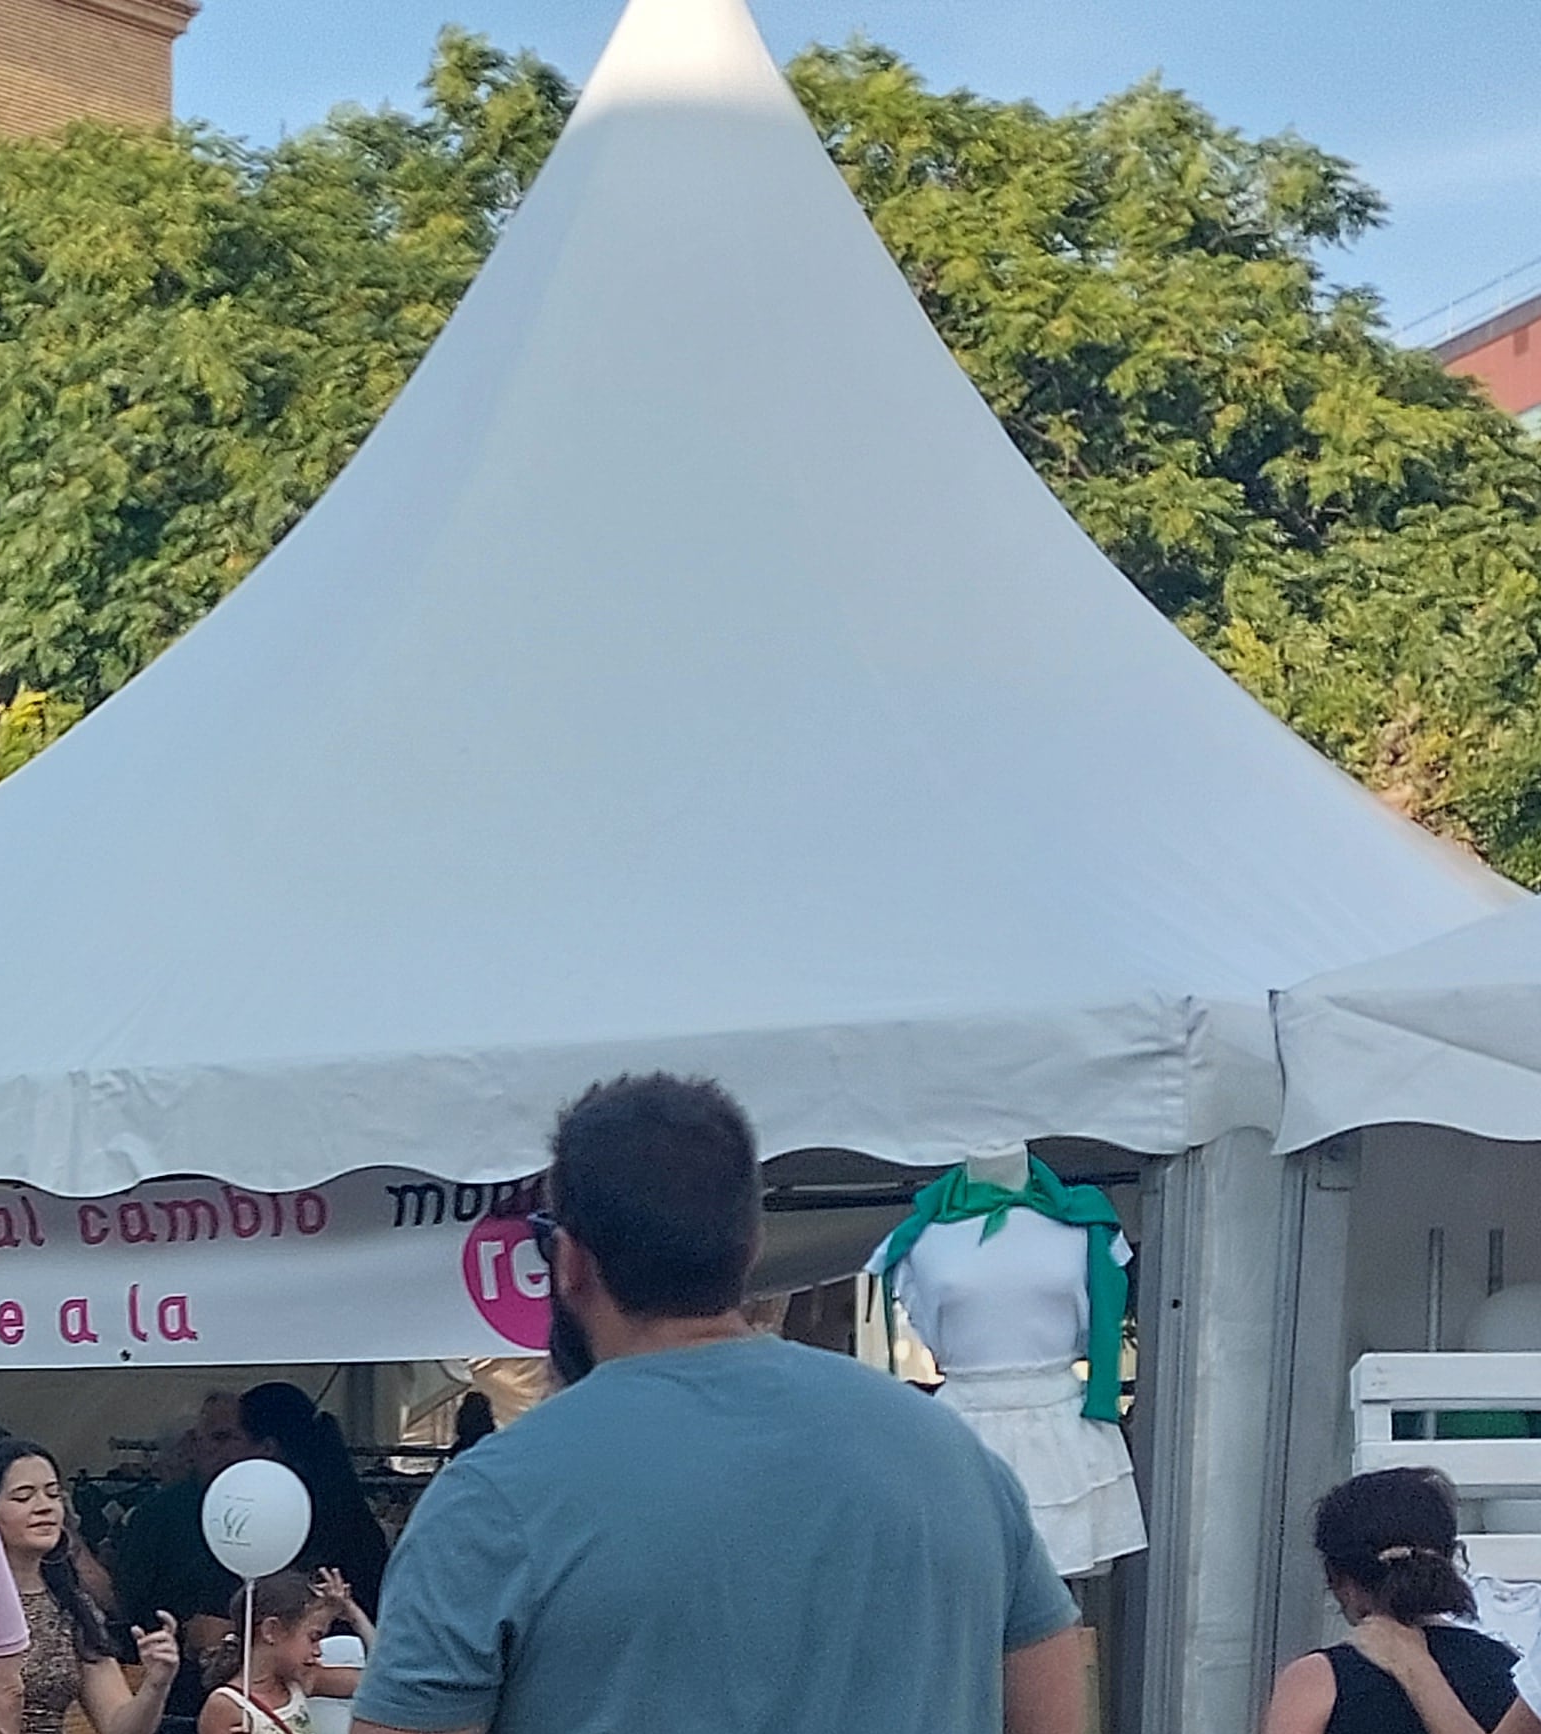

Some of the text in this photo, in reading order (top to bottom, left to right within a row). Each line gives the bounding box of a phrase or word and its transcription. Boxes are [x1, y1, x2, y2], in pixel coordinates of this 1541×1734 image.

[77, 1185, 327, 1246] cambio
[59, 1297, 99, 1345] a
[127, 1282, 199, 1343] la
